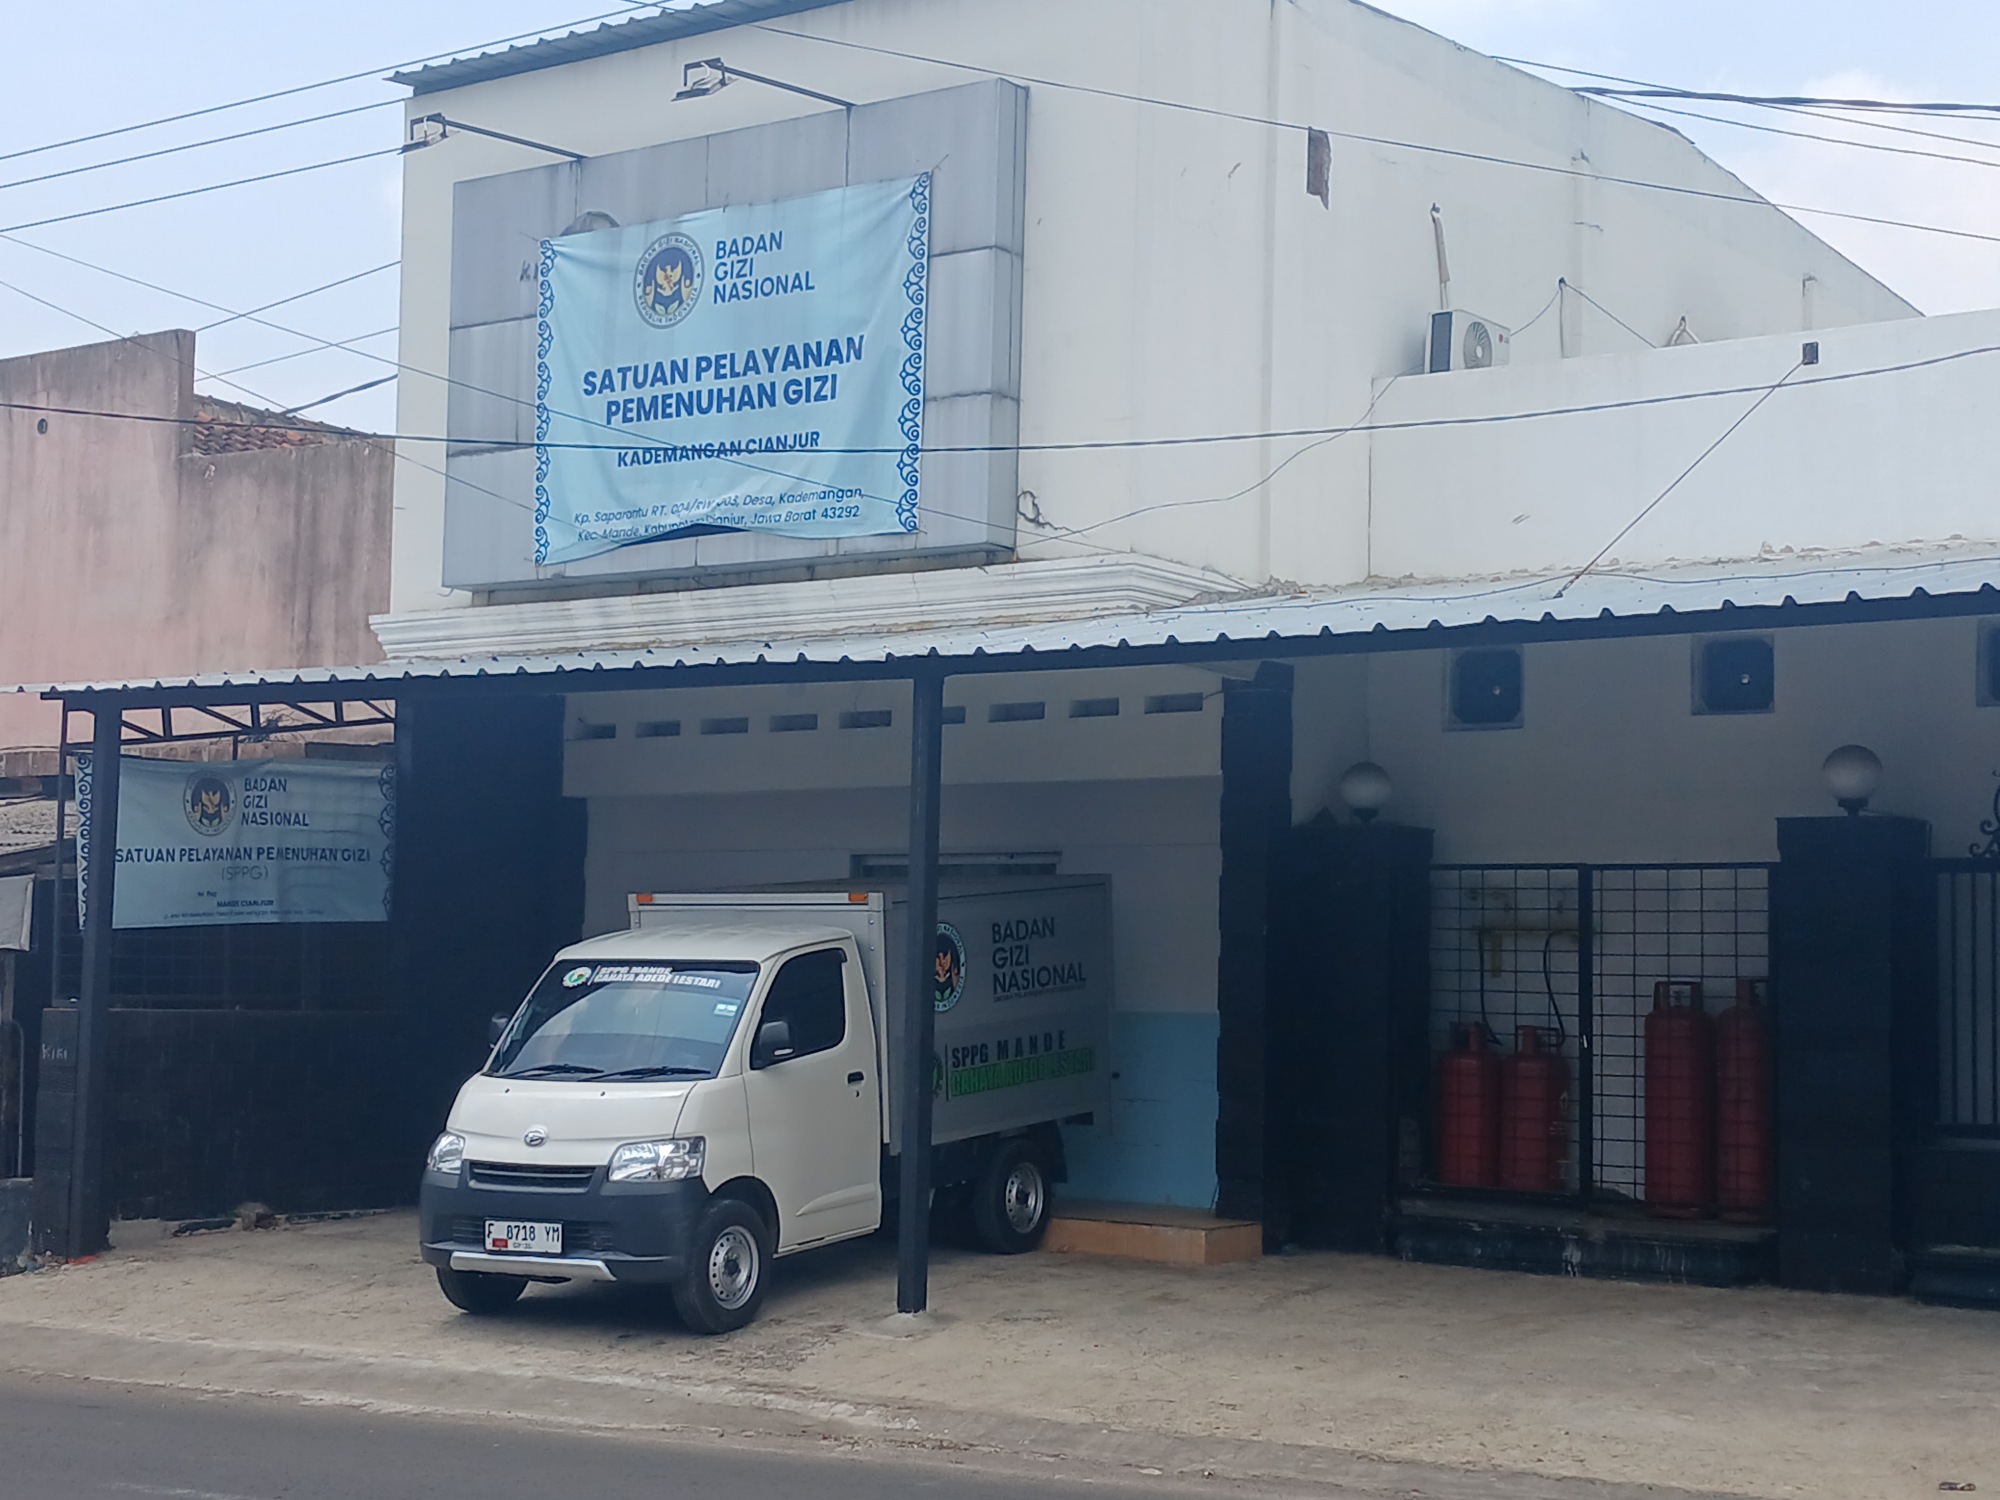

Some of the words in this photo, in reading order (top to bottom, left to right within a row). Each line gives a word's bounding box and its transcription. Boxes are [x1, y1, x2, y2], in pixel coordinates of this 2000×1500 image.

[715, 230, 783, 261] BADAN
[714, 258, 754, 282] GIZI
[713, 271, 815, 304] NASIONAL
[582, 357, 689, 397] SATUAN
[695, 334, 865, 383] PELAYANAN
[606, 381, 777, 426] PEMENUHAN
[783, 373, 838, 406] GIZI
[617, 440, 742, 467] KADEMANGAN
[745, 431, 820, 453] CIANJUR
[574, 513, 591, 526] Kp.
[651, 504, 667, 516] RT.
[742, 494, 775, 507] Desa,
[778, 488, 864, 503] Kademangan,
[750, 513, 781, 525] Jawa
[784, 509, 817, 522] Barat
[821, 505, 860, 519] 43292
[244, 778, 287, 792] BADAN
[243, 795, 268, 809] GIZI
[241, 812, 309, 827] NASIONAL
[115, 848, 175, 863] SATUAN
[180, 847, 251, 862] PELAYANAN
[257, 847, 338, 862] PEMENUHAN
[341, 849, 371, 862] GIZI
[221, 865, 269, 880] (SPPG)
[992, 917, 1055, 944] BADAN
[992, 944, 1029, 969] GIZI
[993, 962, 1086, 995] NASIONAL
[952, 1043, 989, 1069] SPPG
[997, 1030, 1065, 1061] MANDE
